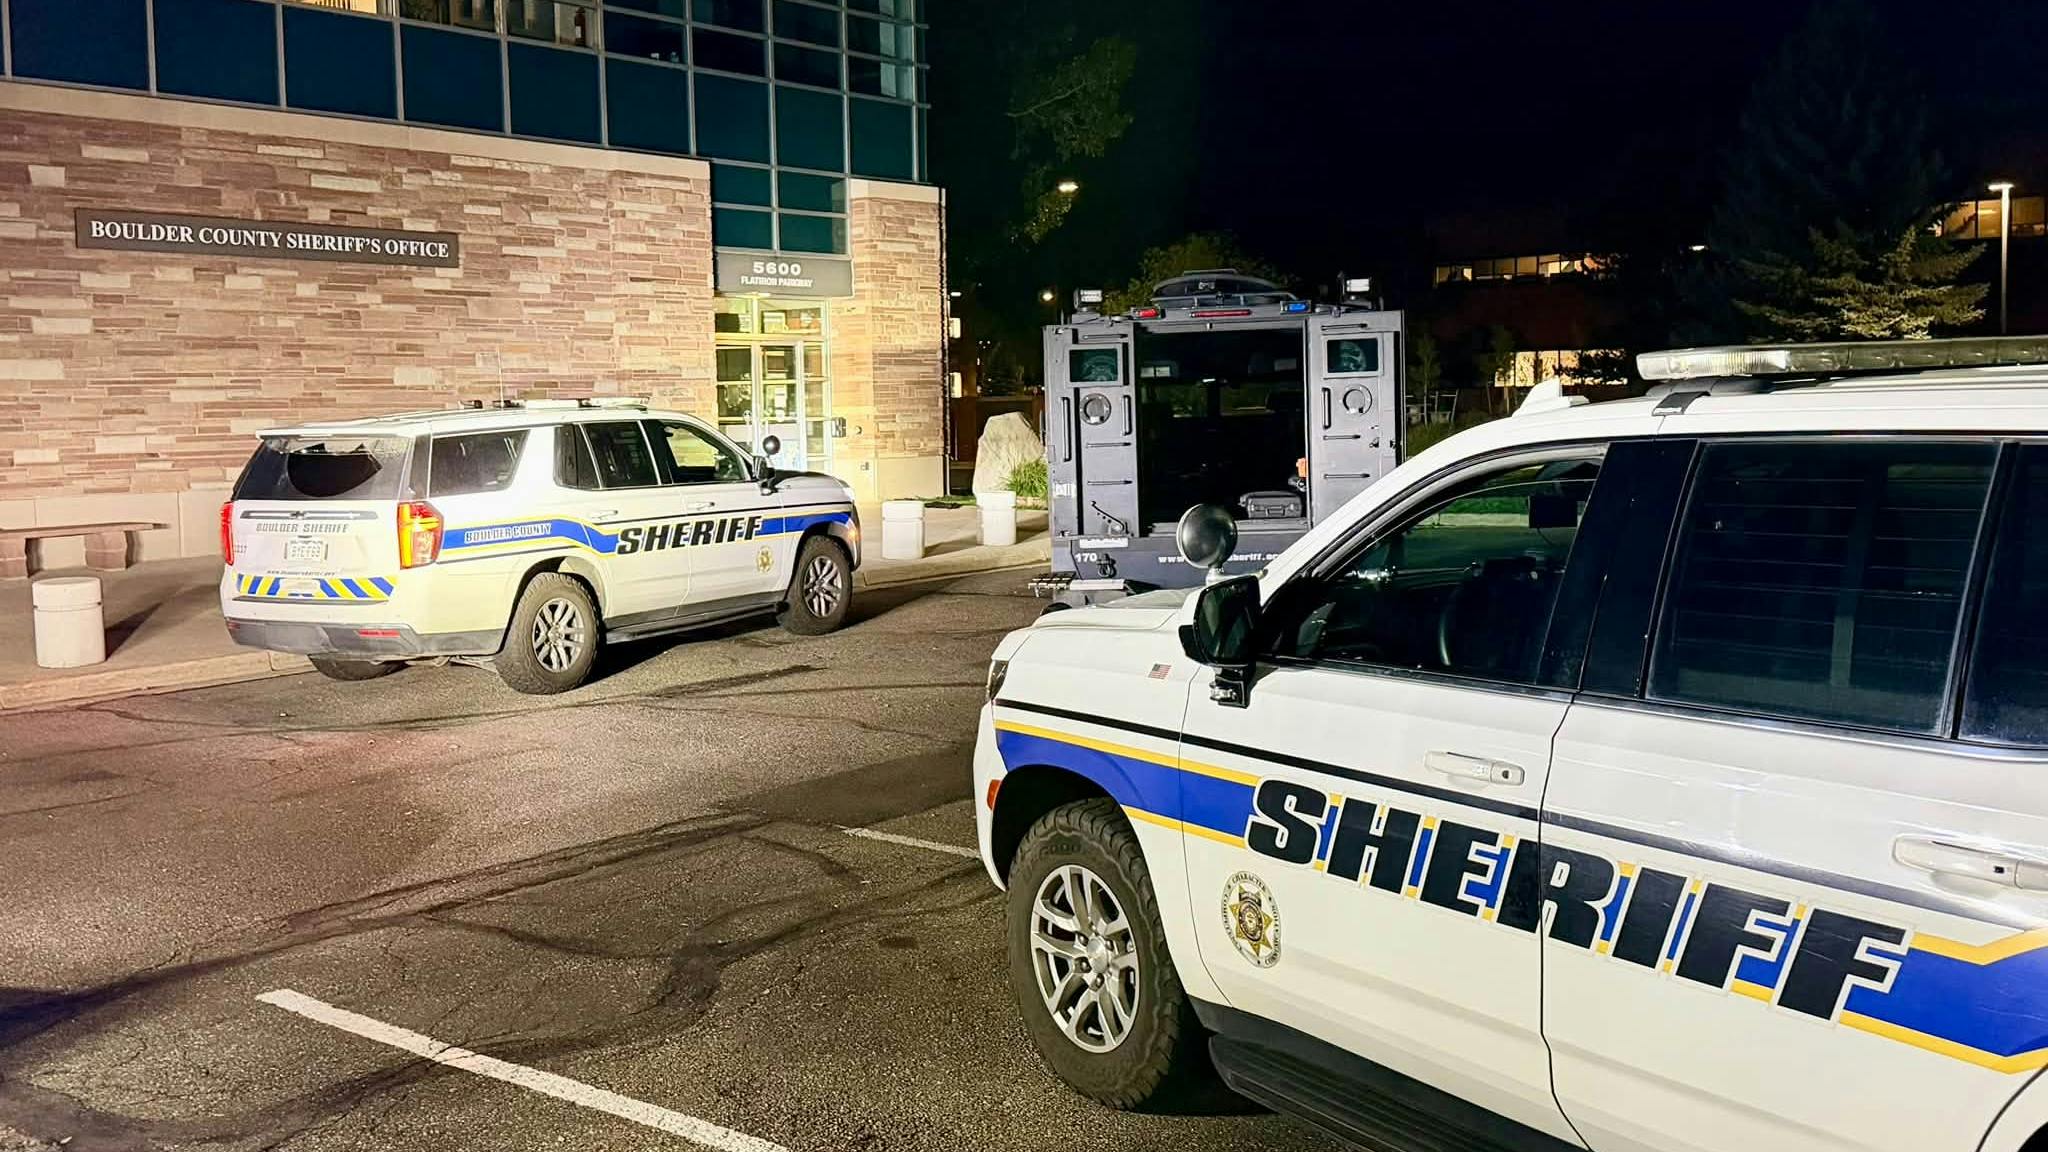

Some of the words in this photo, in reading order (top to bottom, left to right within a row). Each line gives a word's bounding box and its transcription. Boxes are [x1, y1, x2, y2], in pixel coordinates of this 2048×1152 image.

[90, 220, 195, 244] BOULDER
[199, 227, 284, 248] COUNTY
[286, 233, 381, 255] SHERIFF'S
[385, 240, 450, 259] OFFICE
[752, 261, 802, 276] 5600
[255, 522, 298, 533] BOULDER
[303, 523, 350, 533] SHERIFF
[464, 526, 513, 544] BOULDER
[512, 522, 553, 537] COUNTY
[616, 514, 763, 556] SHERIFF
[1074, 552, 1098, 563] 170
[1245, 775, 1913, 1026] SHERIFF
